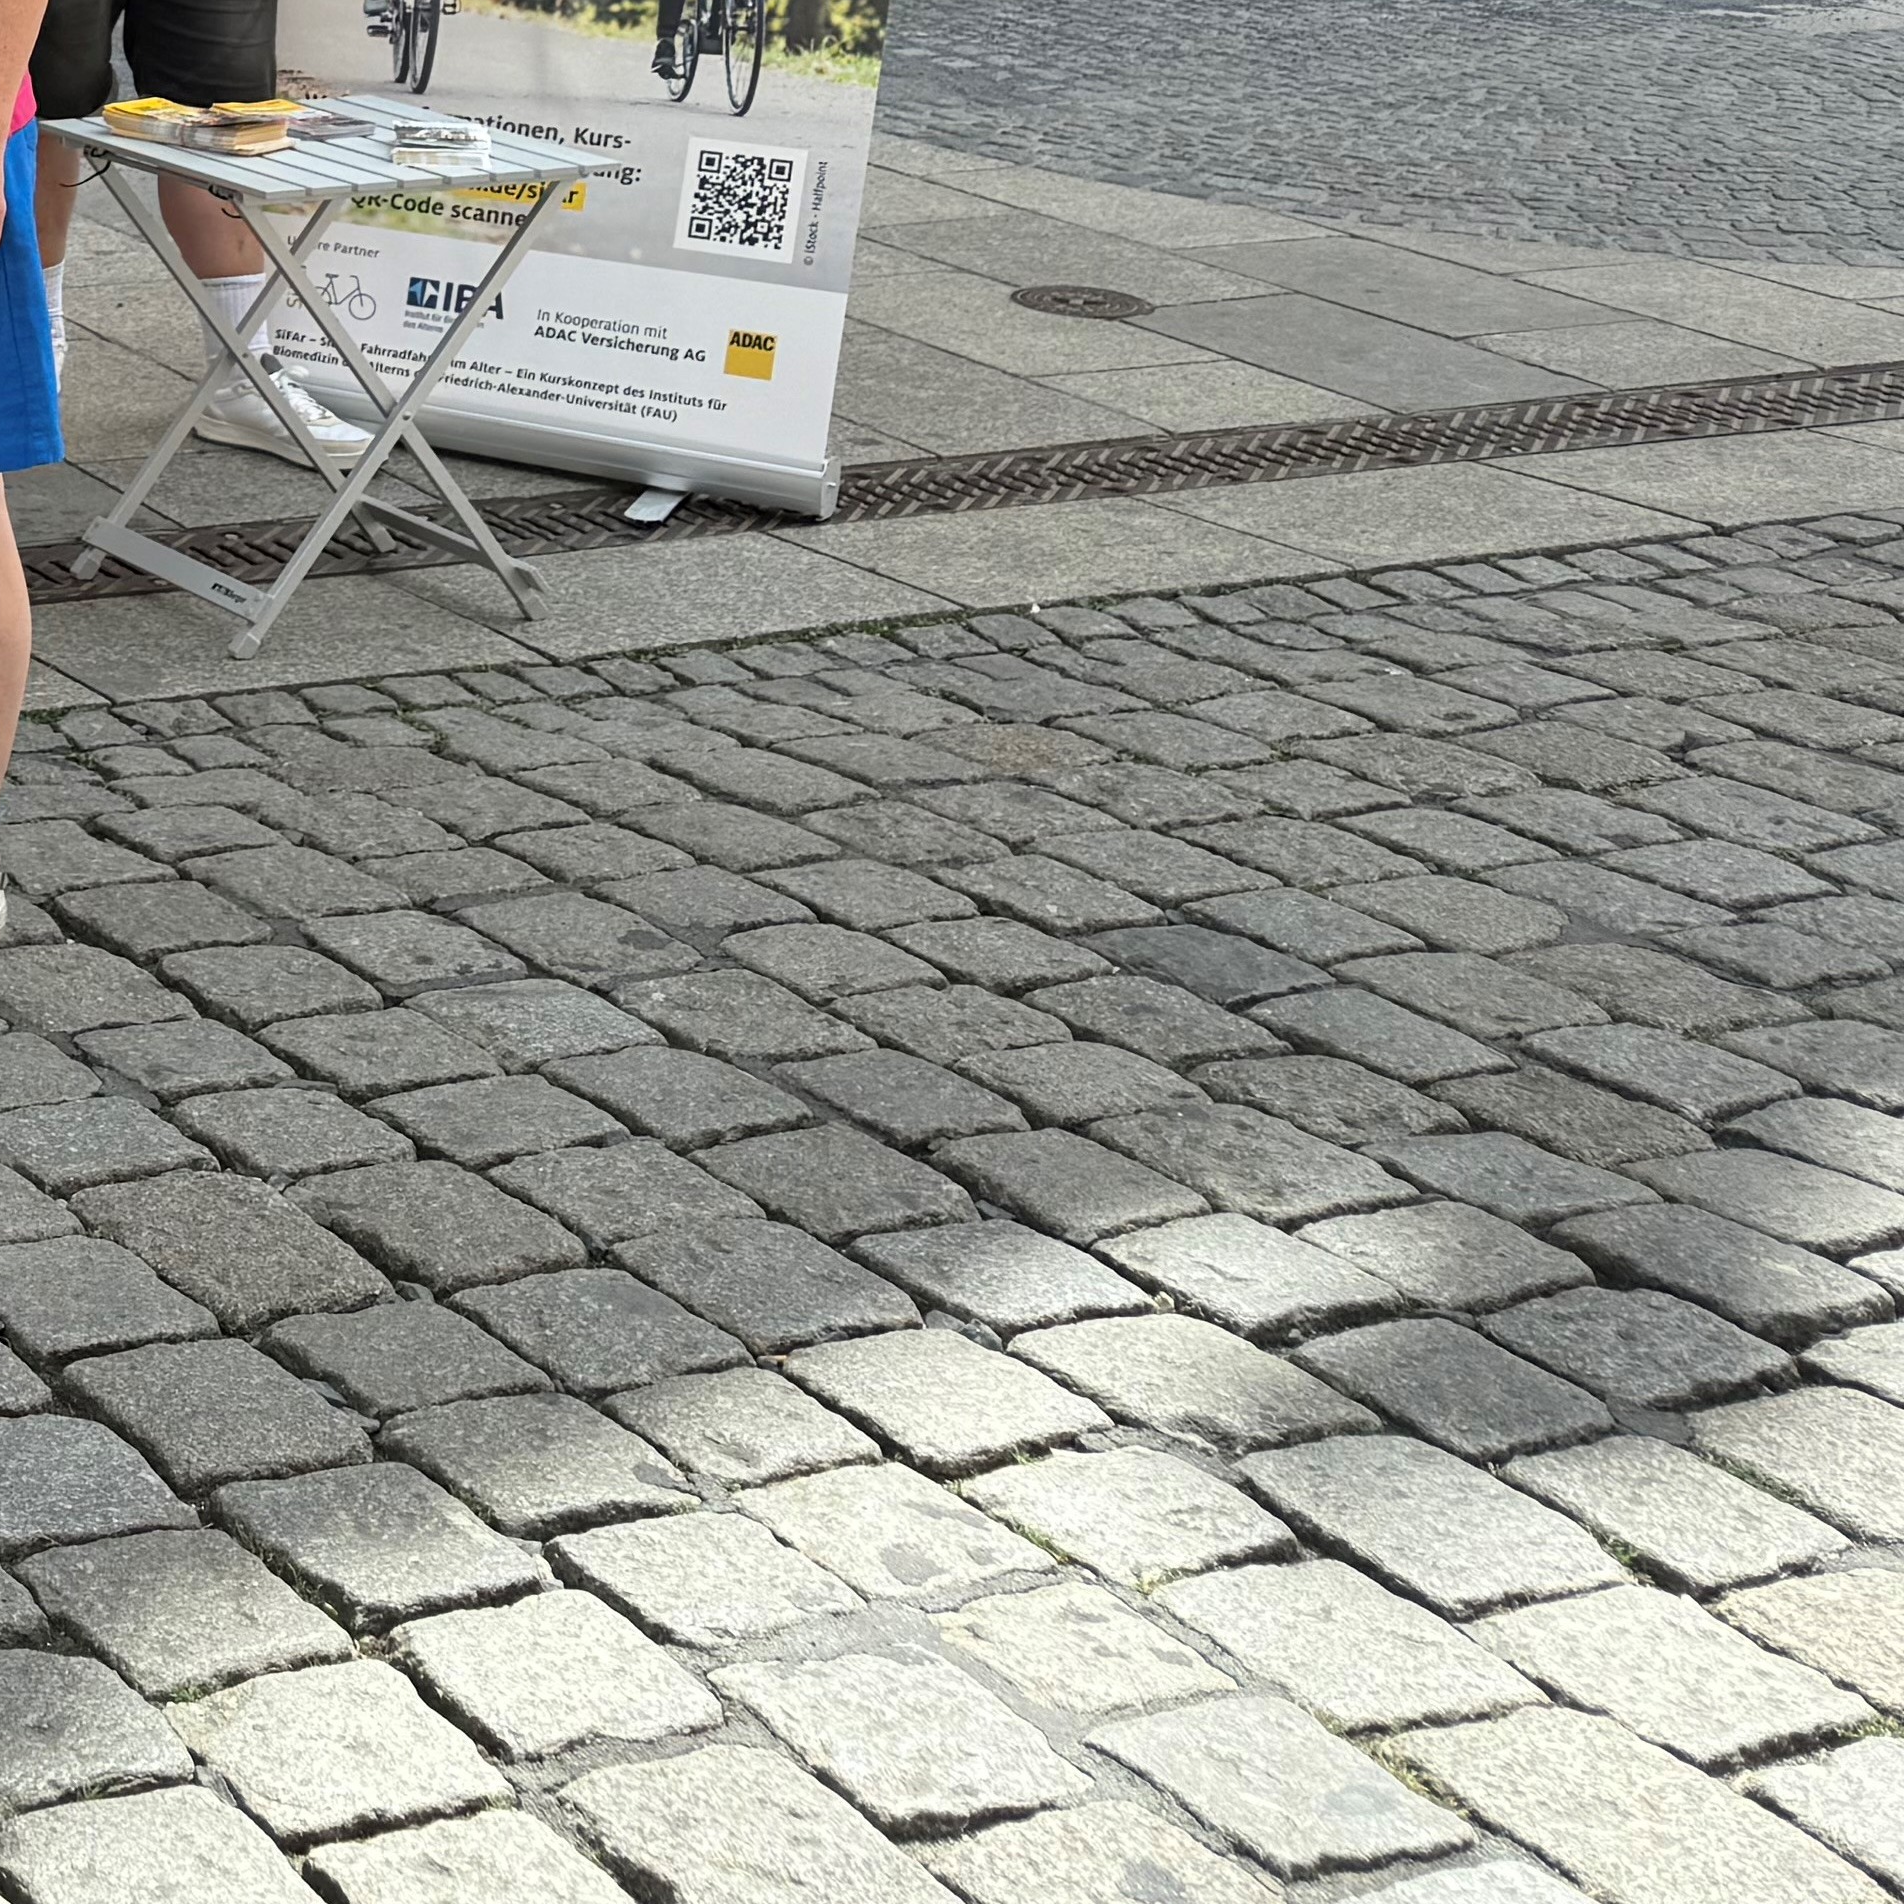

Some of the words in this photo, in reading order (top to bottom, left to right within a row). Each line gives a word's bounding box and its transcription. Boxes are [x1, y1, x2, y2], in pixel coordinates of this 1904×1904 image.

[574, 127, 632, 149] Kurs-
[451, 203, 527, 228] scanne
[334, 243, 381, 259] Partner
[537, 308, 550, 321] In
[555, 311, 640, 336] Kooperation
[643, 326, 668, 340] mit
[534, 325, 577, 342] ADAC
[581, 333, 679, 361] Versicherung
[684, 348, 707, 363] AG
[729, 331, 775, 351] ADAC
[470, 361, 502, 375] Alter
[516, 367, 536, 381] Ein
[540, 372, 620, 396] Kurskonzept
[623, 385, 645, 398] des
[649, 390, 704, 409] Instituts
[707, 397, 729, 411] für
[641, 405, 678, 424] (FAU)
